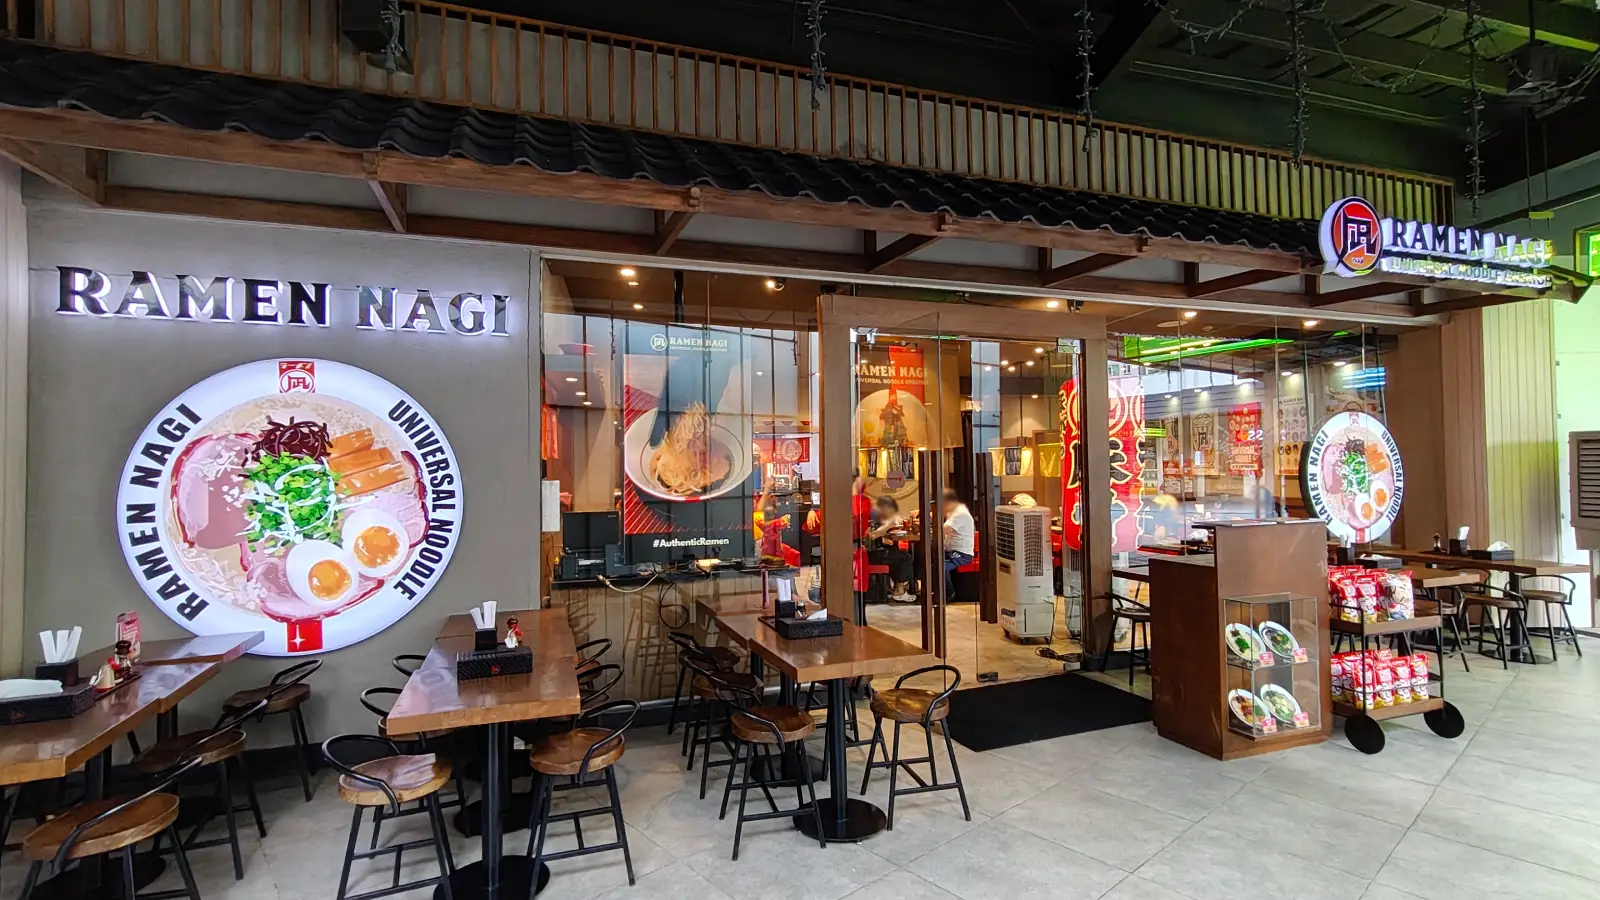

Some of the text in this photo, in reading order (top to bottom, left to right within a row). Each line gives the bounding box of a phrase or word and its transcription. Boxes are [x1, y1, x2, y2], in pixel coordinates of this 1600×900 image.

[1387, 217, 1484, 257] RAMEN
[55, 265, 511, 337] RAMEN NAGI
[669, 337, 728, 348] RAMEN NAGI
[899, 366, 928, 378] NAGI
[126, 402, 210, 622] RAMEN NAGI
[388, 399, 456, 601] UNIVERSAL NOODLE
[1308, 429, 1333, 526] RAMEN NAGI
[1381, 429, 1403, 524] UNIVERSAL NOODLE
[653, 537, 730, 548] #AuthenticRamen
